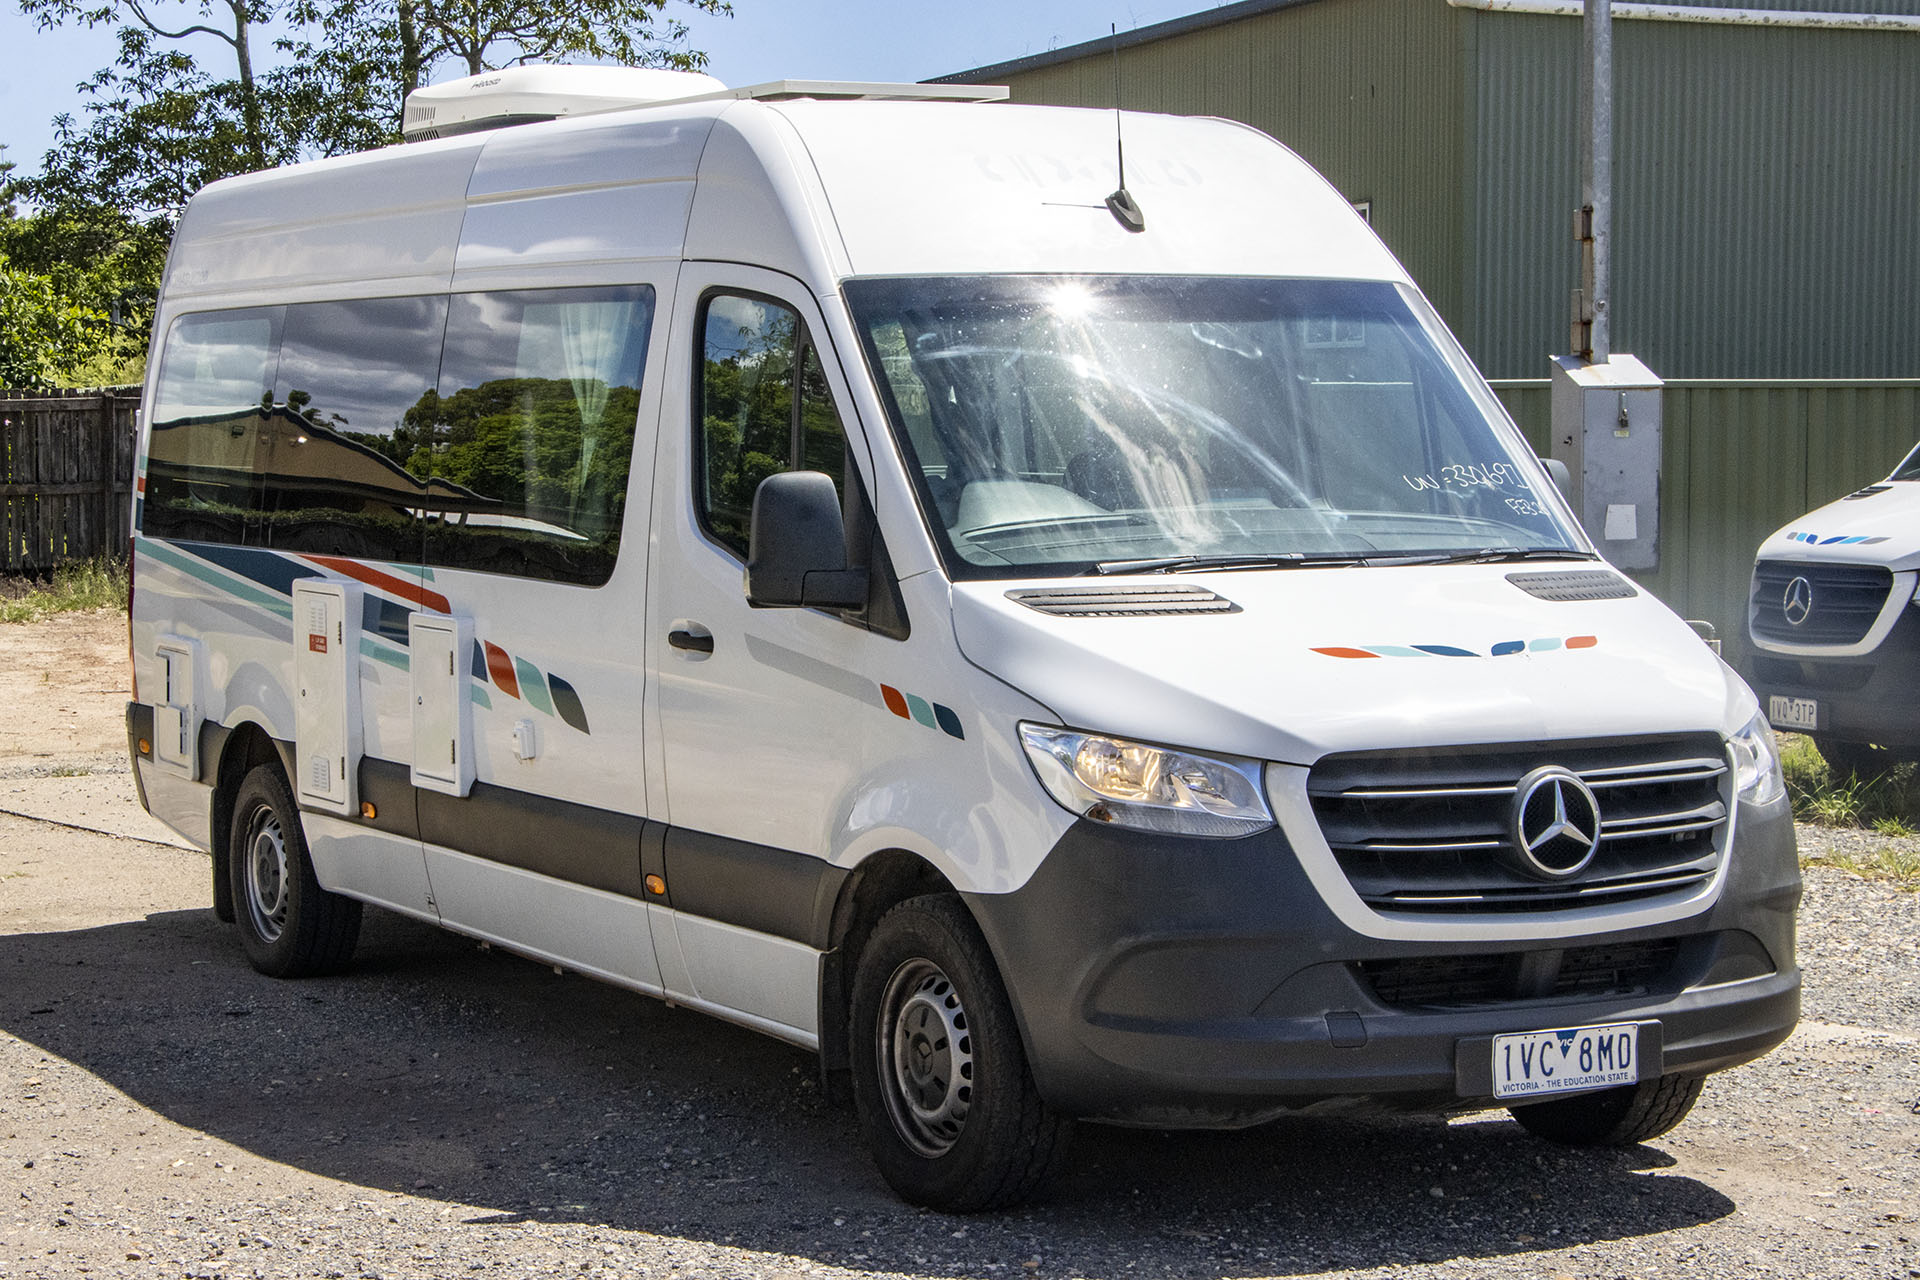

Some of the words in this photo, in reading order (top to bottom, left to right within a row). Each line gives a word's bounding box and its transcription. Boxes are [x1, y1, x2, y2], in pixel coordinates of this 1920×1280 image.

[1795, 703, 1815, 722] 3TP
[1559, 1038, 1573, 1047] VIC
[1504, 1040, 1554, 1081] 1VC
[1579, 1033, 1631, 1073] 8MD
[1502, 1081, 1539, 1093] VICTORIA
[1546, 1079, 1561, 1089] THE
[1564, 1074, 1606, 1087] EDUCATION
[1608, 1071, 1629, 1083] STATE
